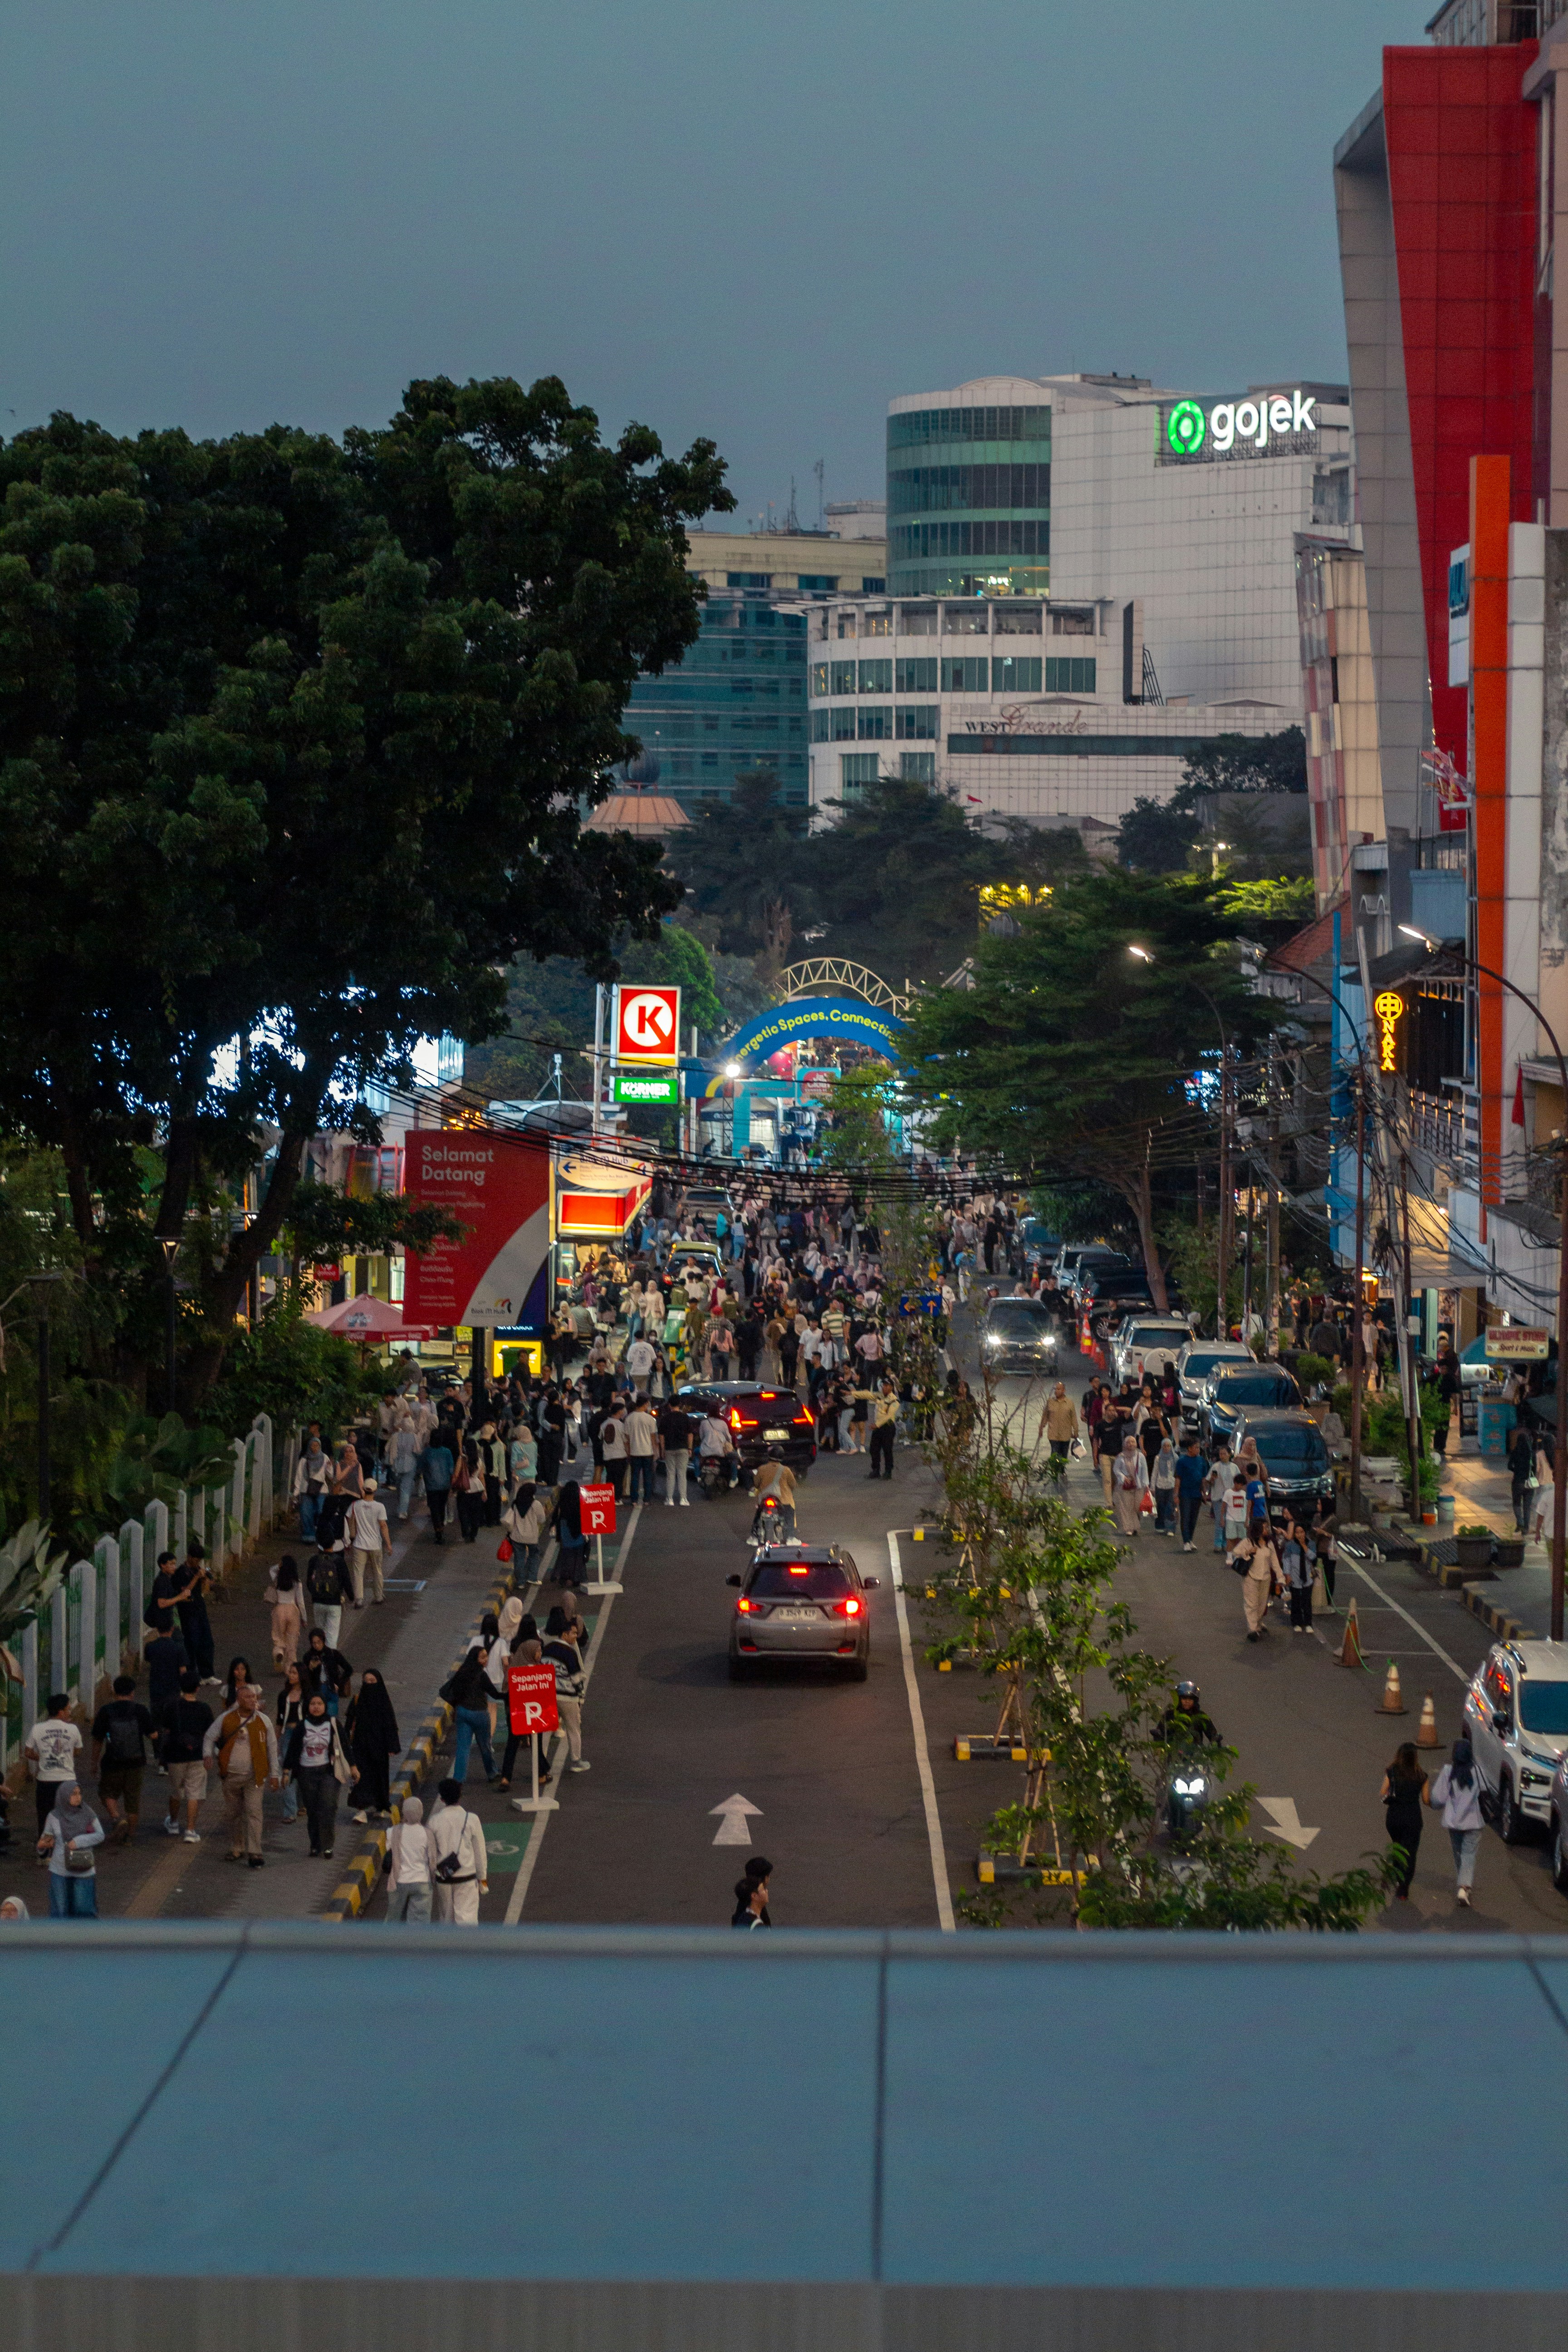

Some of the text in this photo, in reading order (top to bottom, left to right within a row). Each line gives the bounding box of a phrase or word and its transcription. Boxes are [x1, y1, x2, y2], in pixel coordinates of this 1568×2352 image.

[1210, 390, 1317, 451] gojek
[965, 704, 1088, 735] WEST Grande
[638, 1005, 667, 1044] K
[778, 1011, 829, 1031] Spaces,
[1380, 1019, 1396, 1071] NAKA
[620, 1082, 671, 1096] KÖRNER
[421, 1145, 494, 1162] Selamat
[421, 1164, 485, 1186] Datang
[1522, 1330, 1546, 1342] STORE
[584, 1489, 612, 1497] epanjang
[511, 1672, 553, 1684] Sepanjang
[516, 1681, 549, 1692] Jalan Ini
